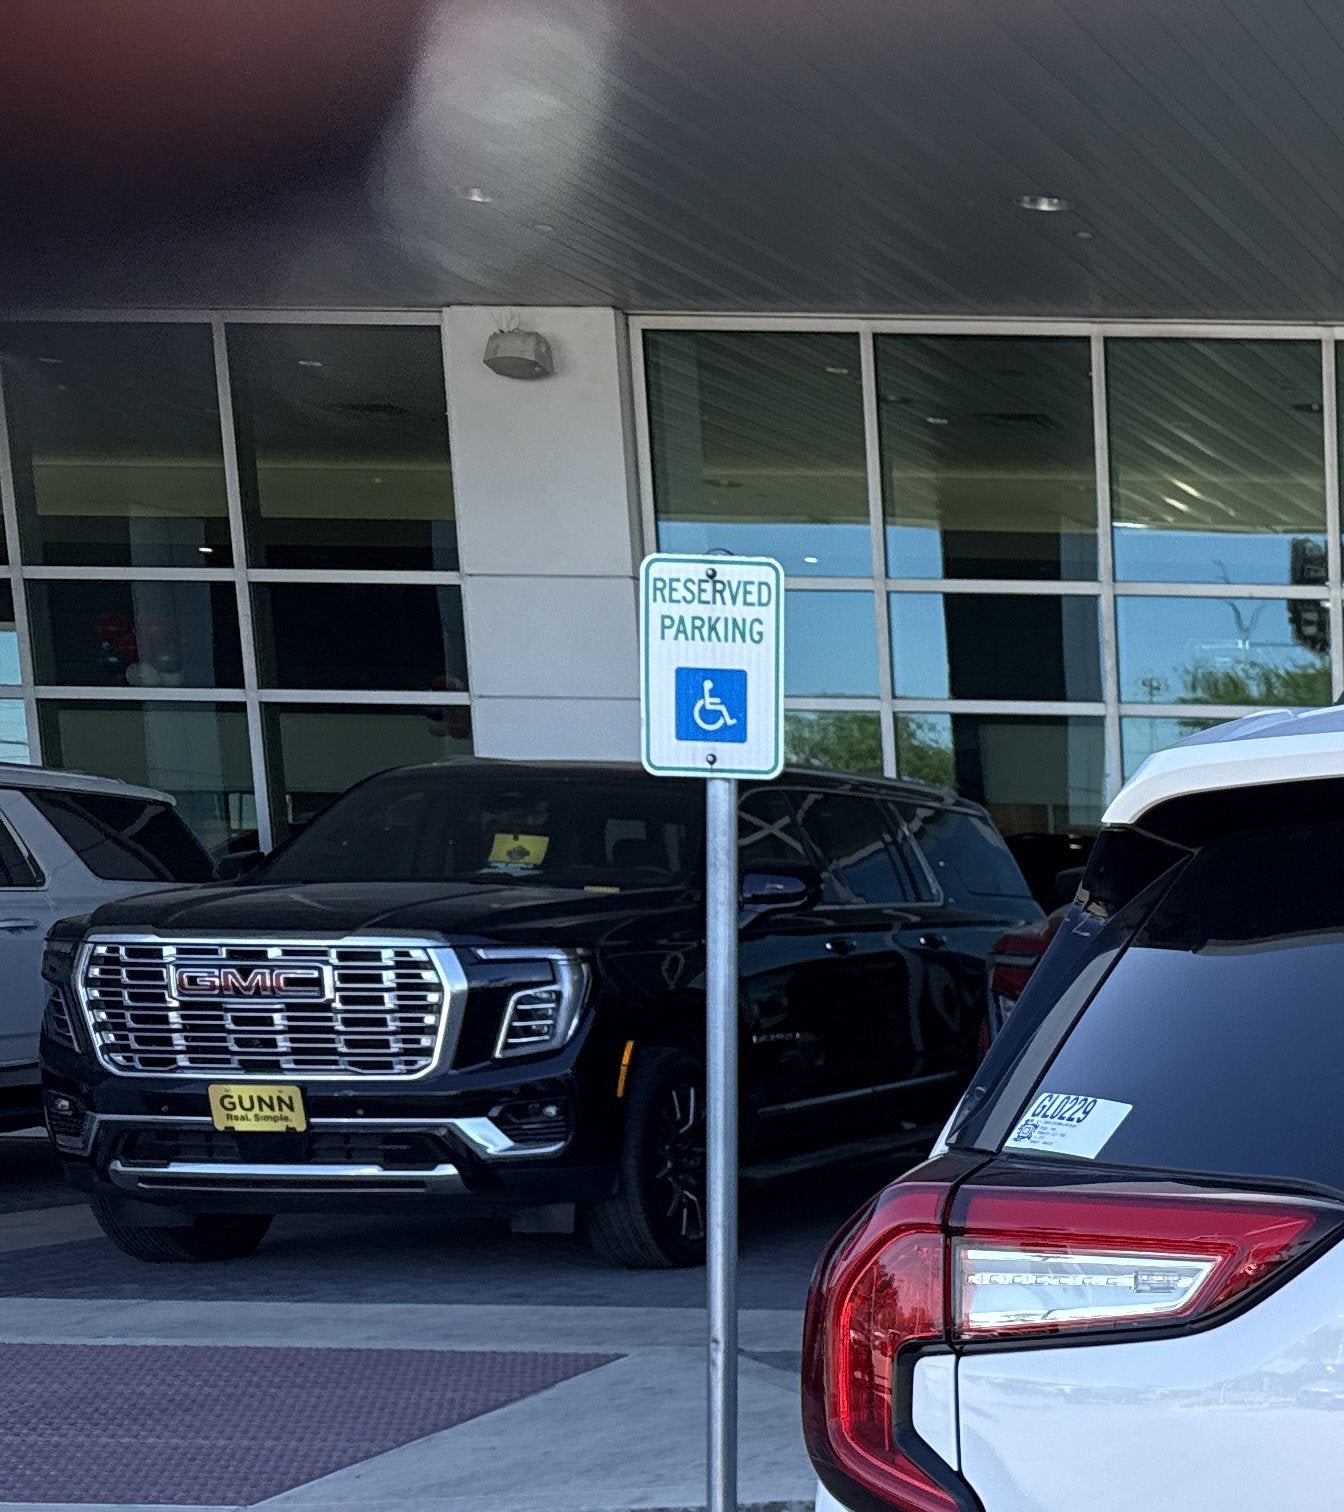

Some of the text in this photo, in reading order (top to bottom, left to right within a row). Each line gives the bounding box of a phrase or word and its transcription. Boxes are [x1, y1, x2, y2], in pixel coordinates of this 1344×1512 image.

[652, 577, 772, 607] RESERVED
[660, 614, 764, 644] PARKING
[176, 968, 321, 996] GMC
[219, 1094, 295, 1112] GUNN
